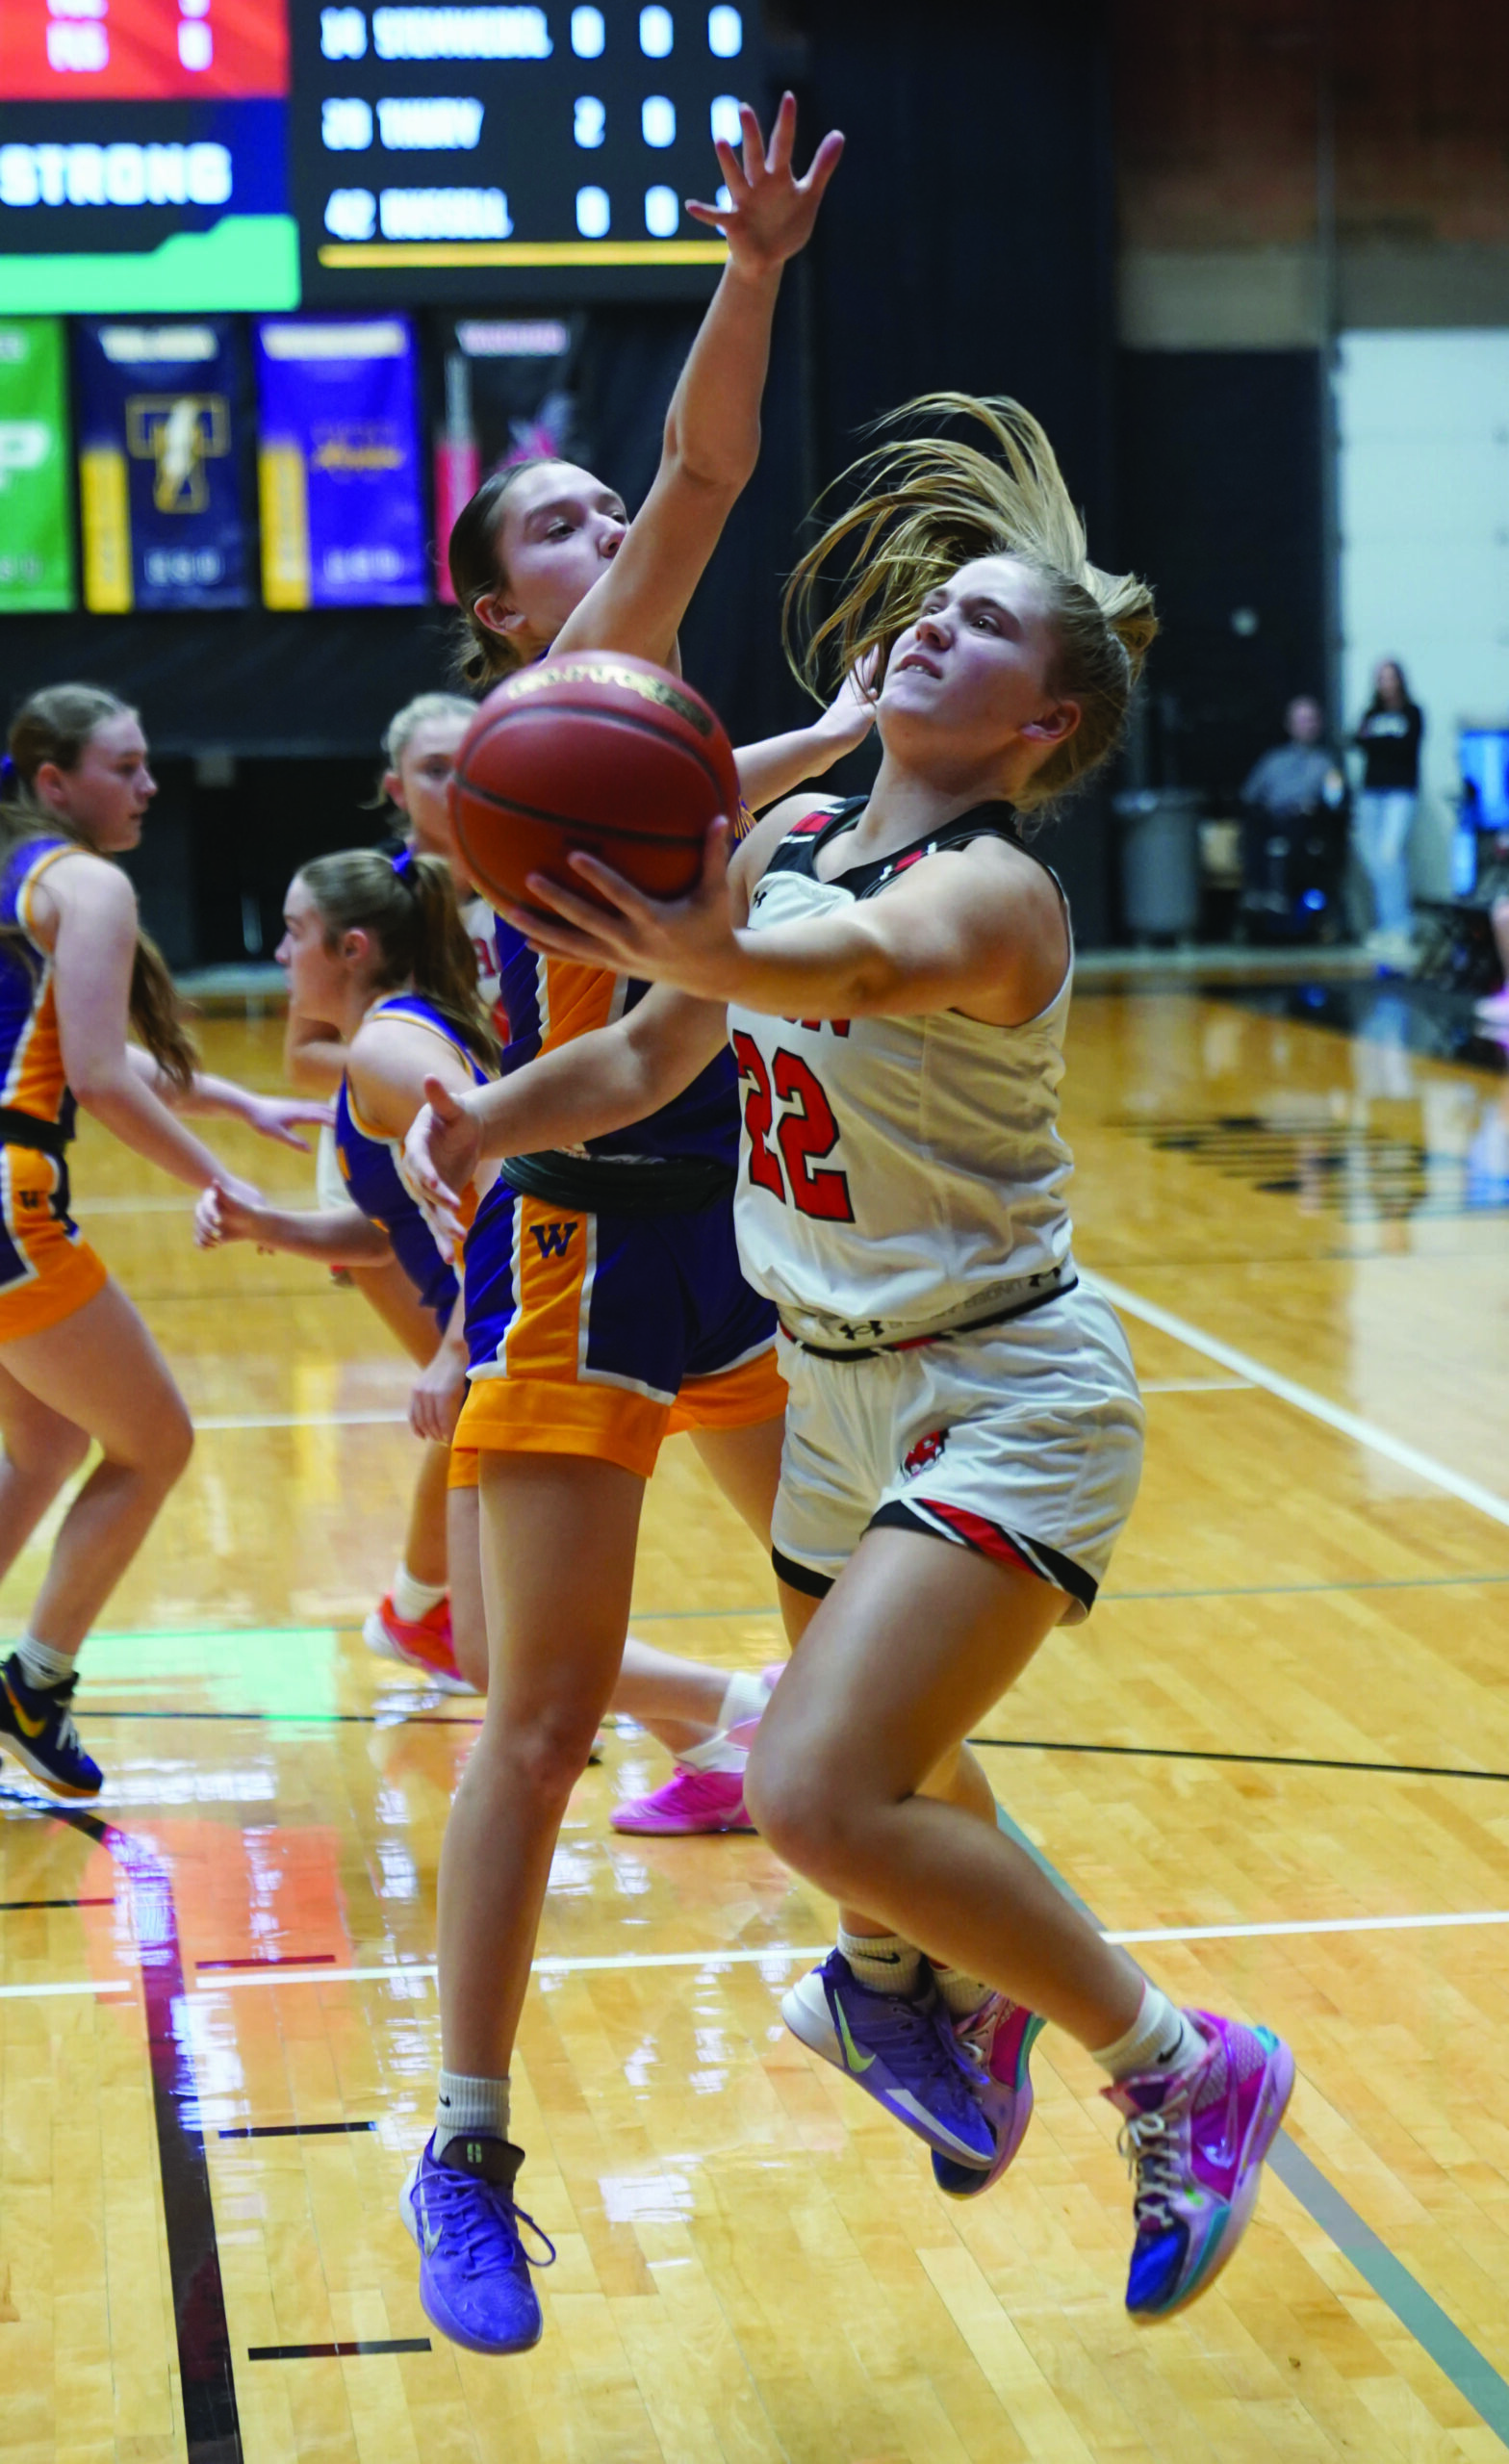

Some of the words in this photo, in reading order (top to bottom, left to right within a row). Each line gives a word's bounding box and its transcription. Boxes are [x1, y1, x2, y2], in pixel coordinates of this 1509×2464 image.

[0, 141, 232, 206] STRONG
[732, 1028, 856, 1223] 22
[529, 1221, 578, 1259] W
